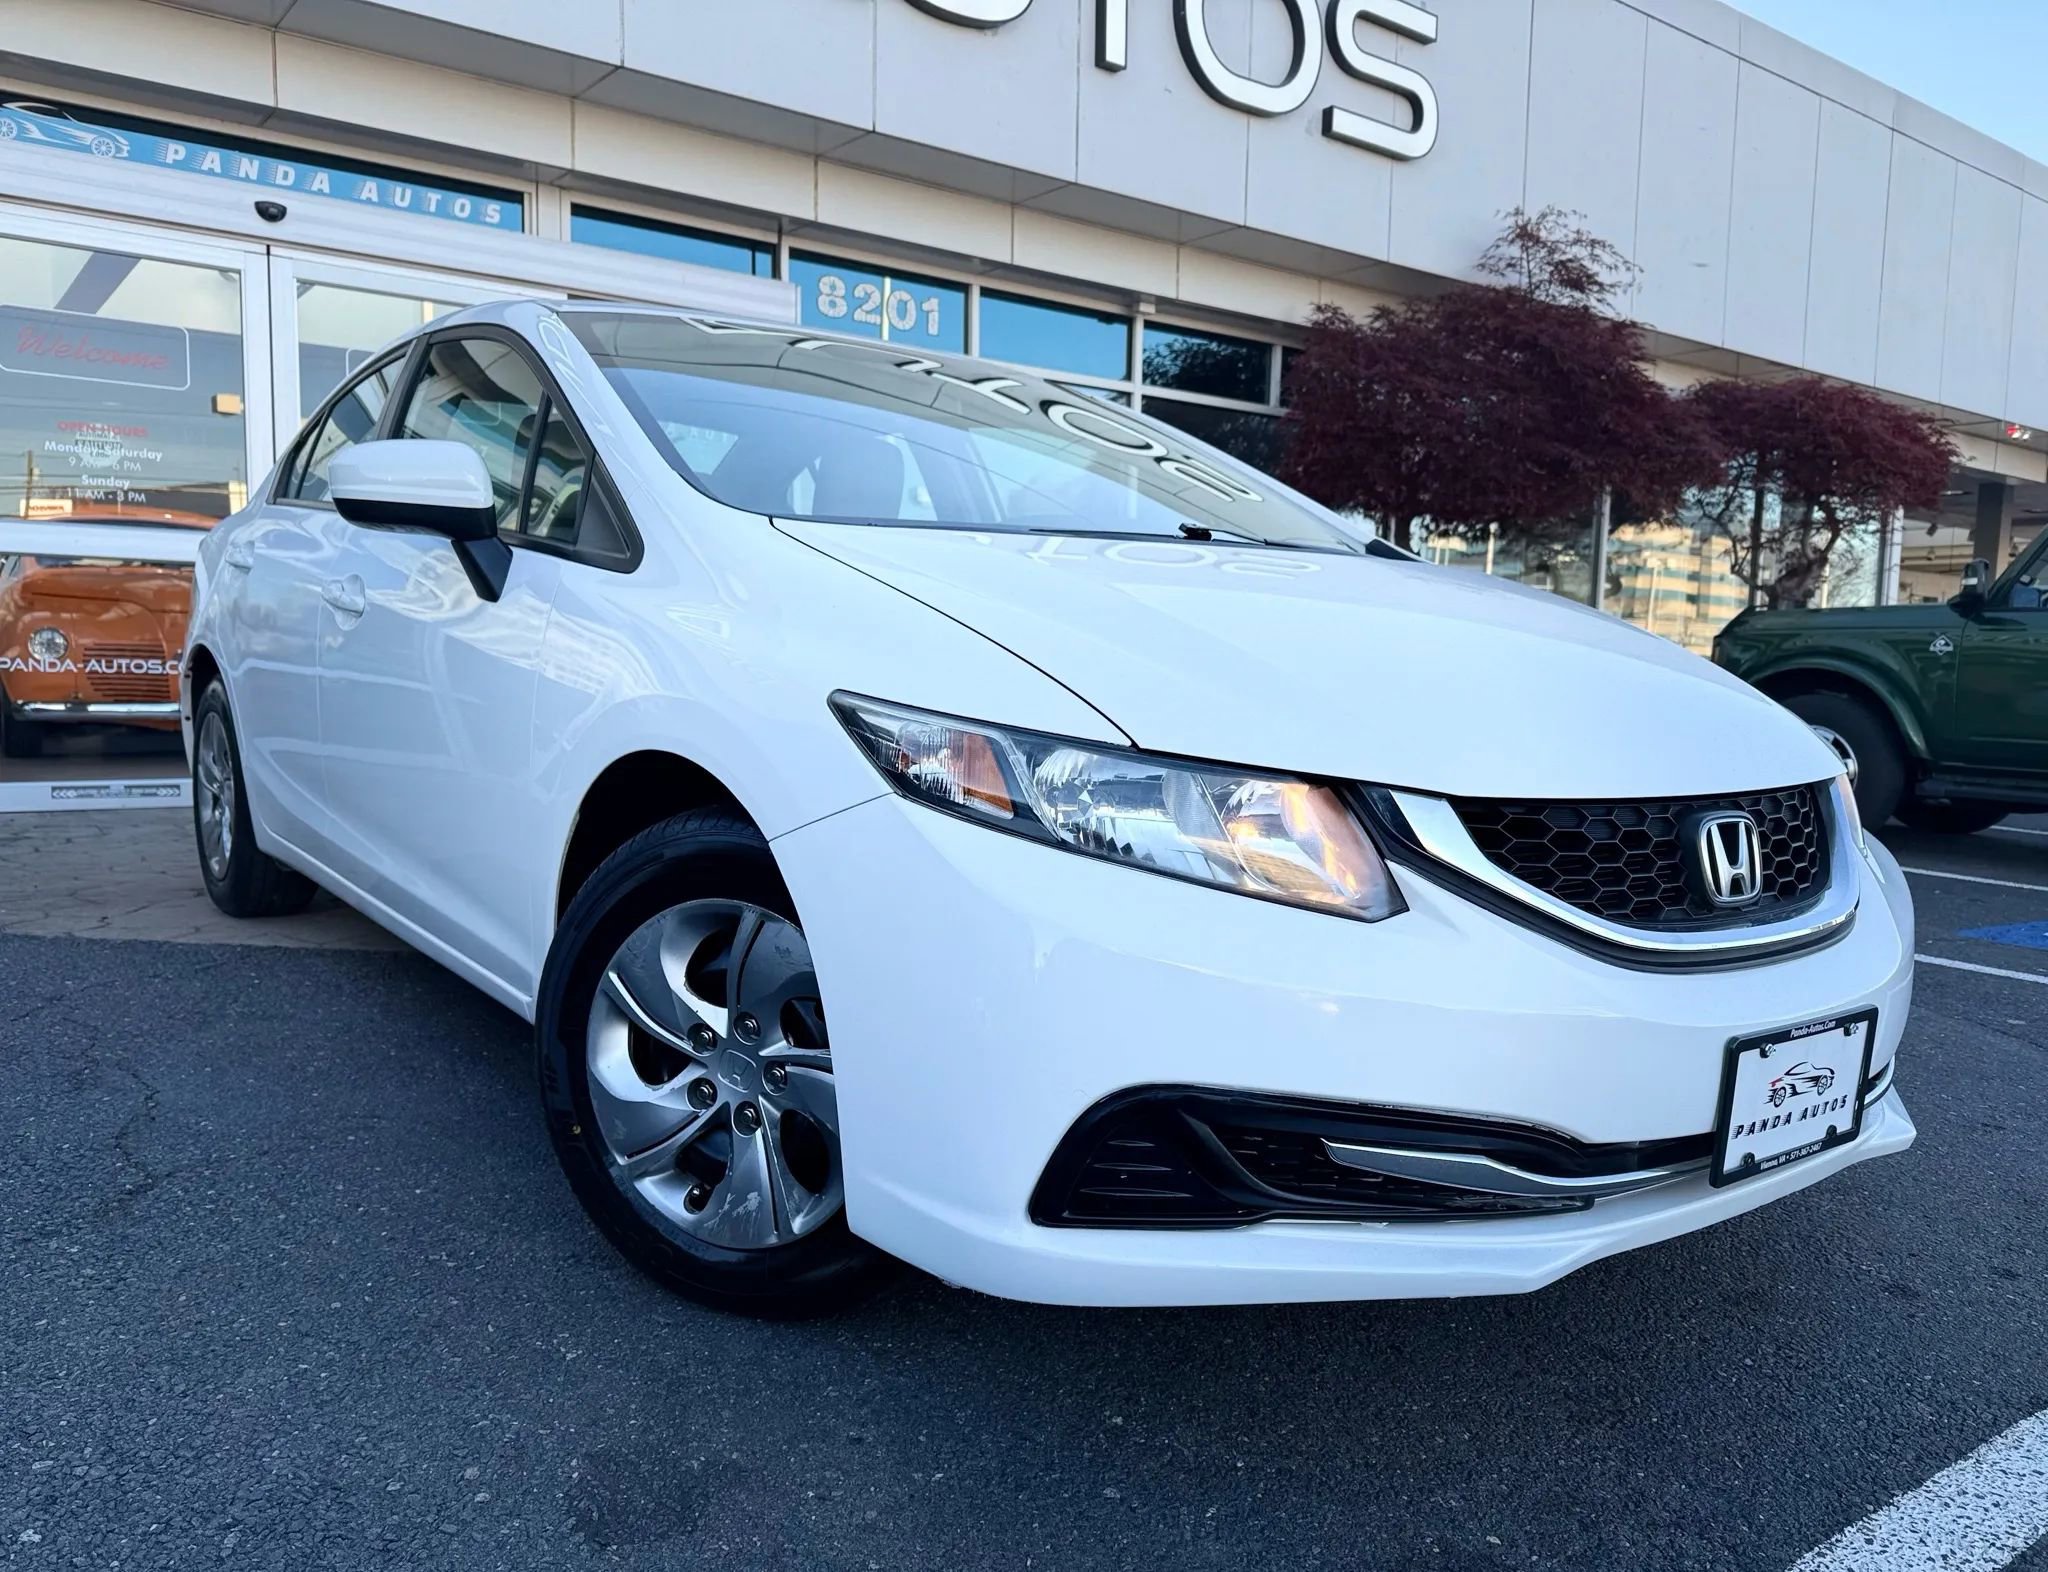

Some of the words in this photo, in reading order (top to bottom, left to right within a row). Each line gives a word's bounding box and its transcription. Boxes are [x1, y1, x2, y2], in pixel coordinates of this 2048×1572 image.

[908, 0, 1439, 161] OS
[153, 142, 331, 194] PANDA
[354, 180, 501, 225] AUTOS
[815, 273, 941, 337] 8201
[16, 321, 170, 369] Welcome
[44, 440, 163, 462] Monday-Saturday
[68, 456, 76, 467] 9
[124, 460, 142, 472] PM
[81, 474, 131, 490] Sunday
[128, 491, 147, 503] PM
[0, 655, 184, 675] PANDA-AUTOS.C
[1731, 1111, 1793, 1140] PANDA
[1797, 1094, 1849, 1123] AUTOS
